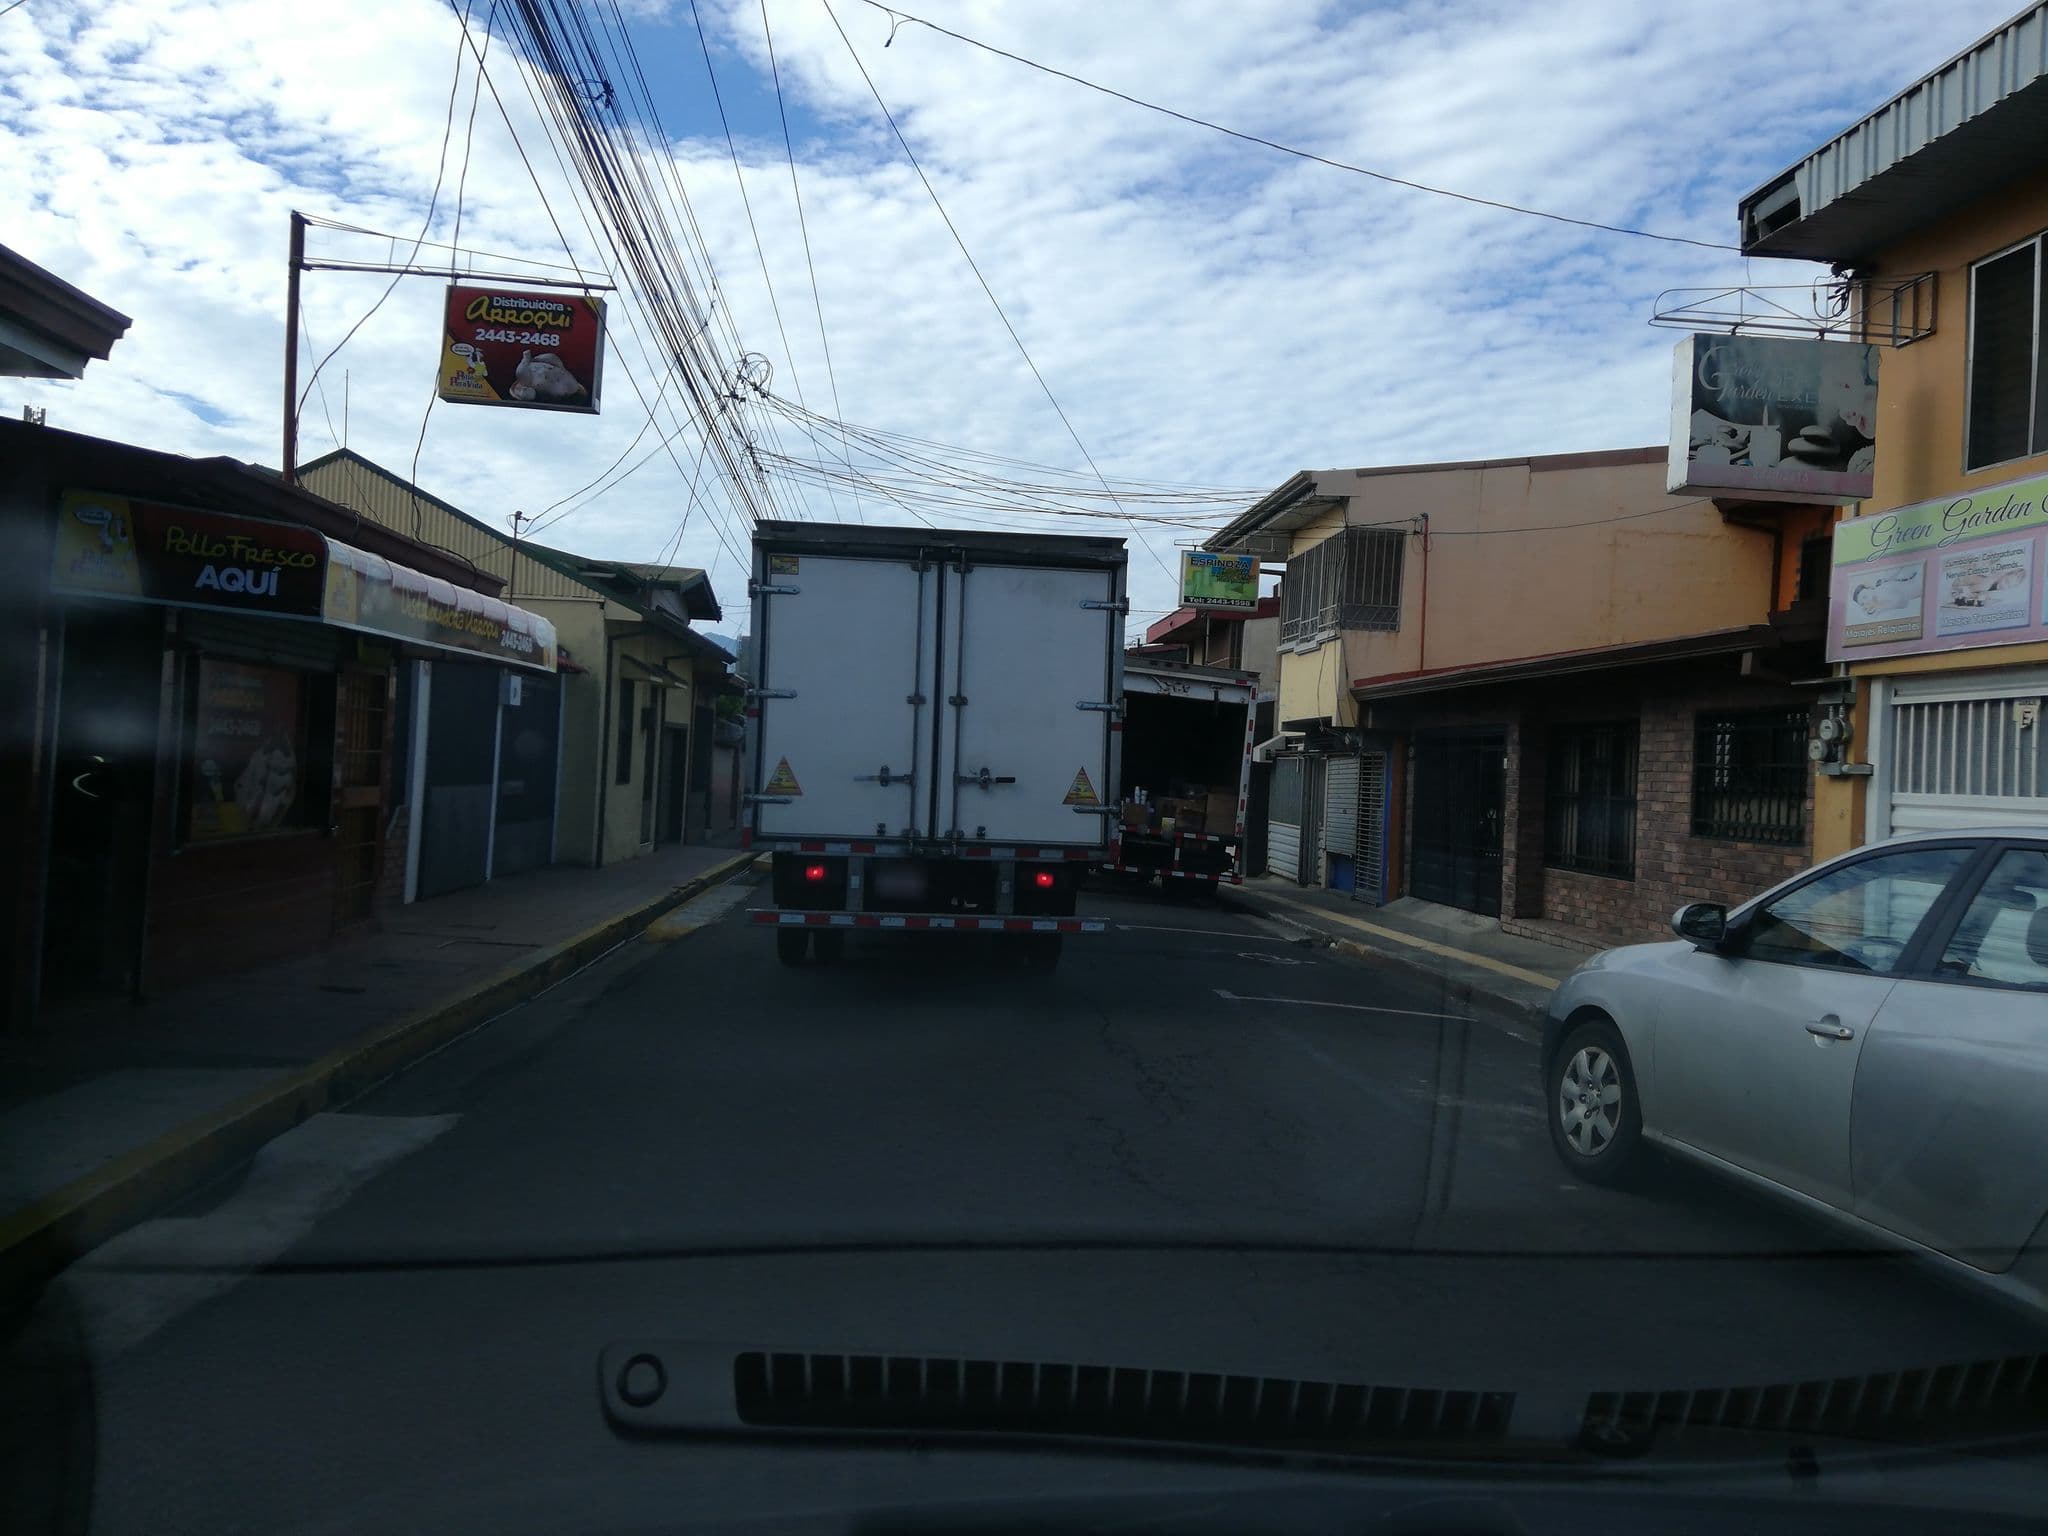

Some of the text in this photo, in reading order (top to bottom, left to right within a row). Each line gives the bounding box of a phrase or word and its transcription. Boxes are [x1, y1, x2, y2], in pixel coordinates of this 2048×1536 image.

[493, 297, 564, 311] Distribuidora
[475, 328, 560, 346] 2443-2468
[1866, 515, 1933, 563] Green
[1937, 493, 2032, 548] Garden
[1191, 556, 1249, 569] ESPINOZA
